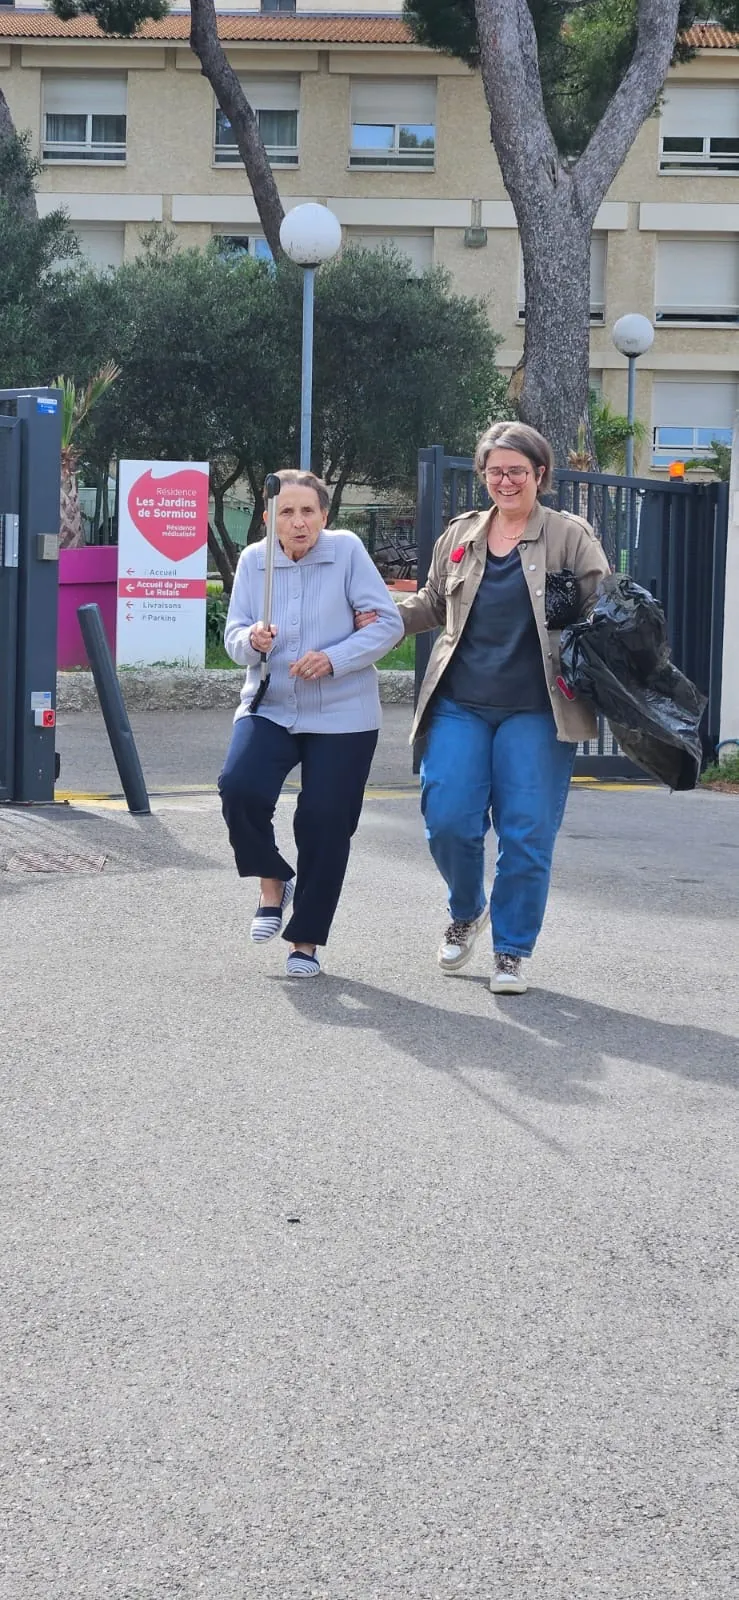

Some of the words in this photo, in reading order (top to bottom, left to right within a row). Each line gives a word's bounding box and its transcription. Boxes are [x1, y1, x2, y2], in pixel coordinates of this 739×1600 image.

[156, 488, 197, 496] Résidence
[136, 497, 154, 506] Les
[158, 498, 196, 507] Jardins
[138, 508, 150, 517] de
[154, 508, 196, 518] Sormiou
[174, 582, 189, 590] jour
